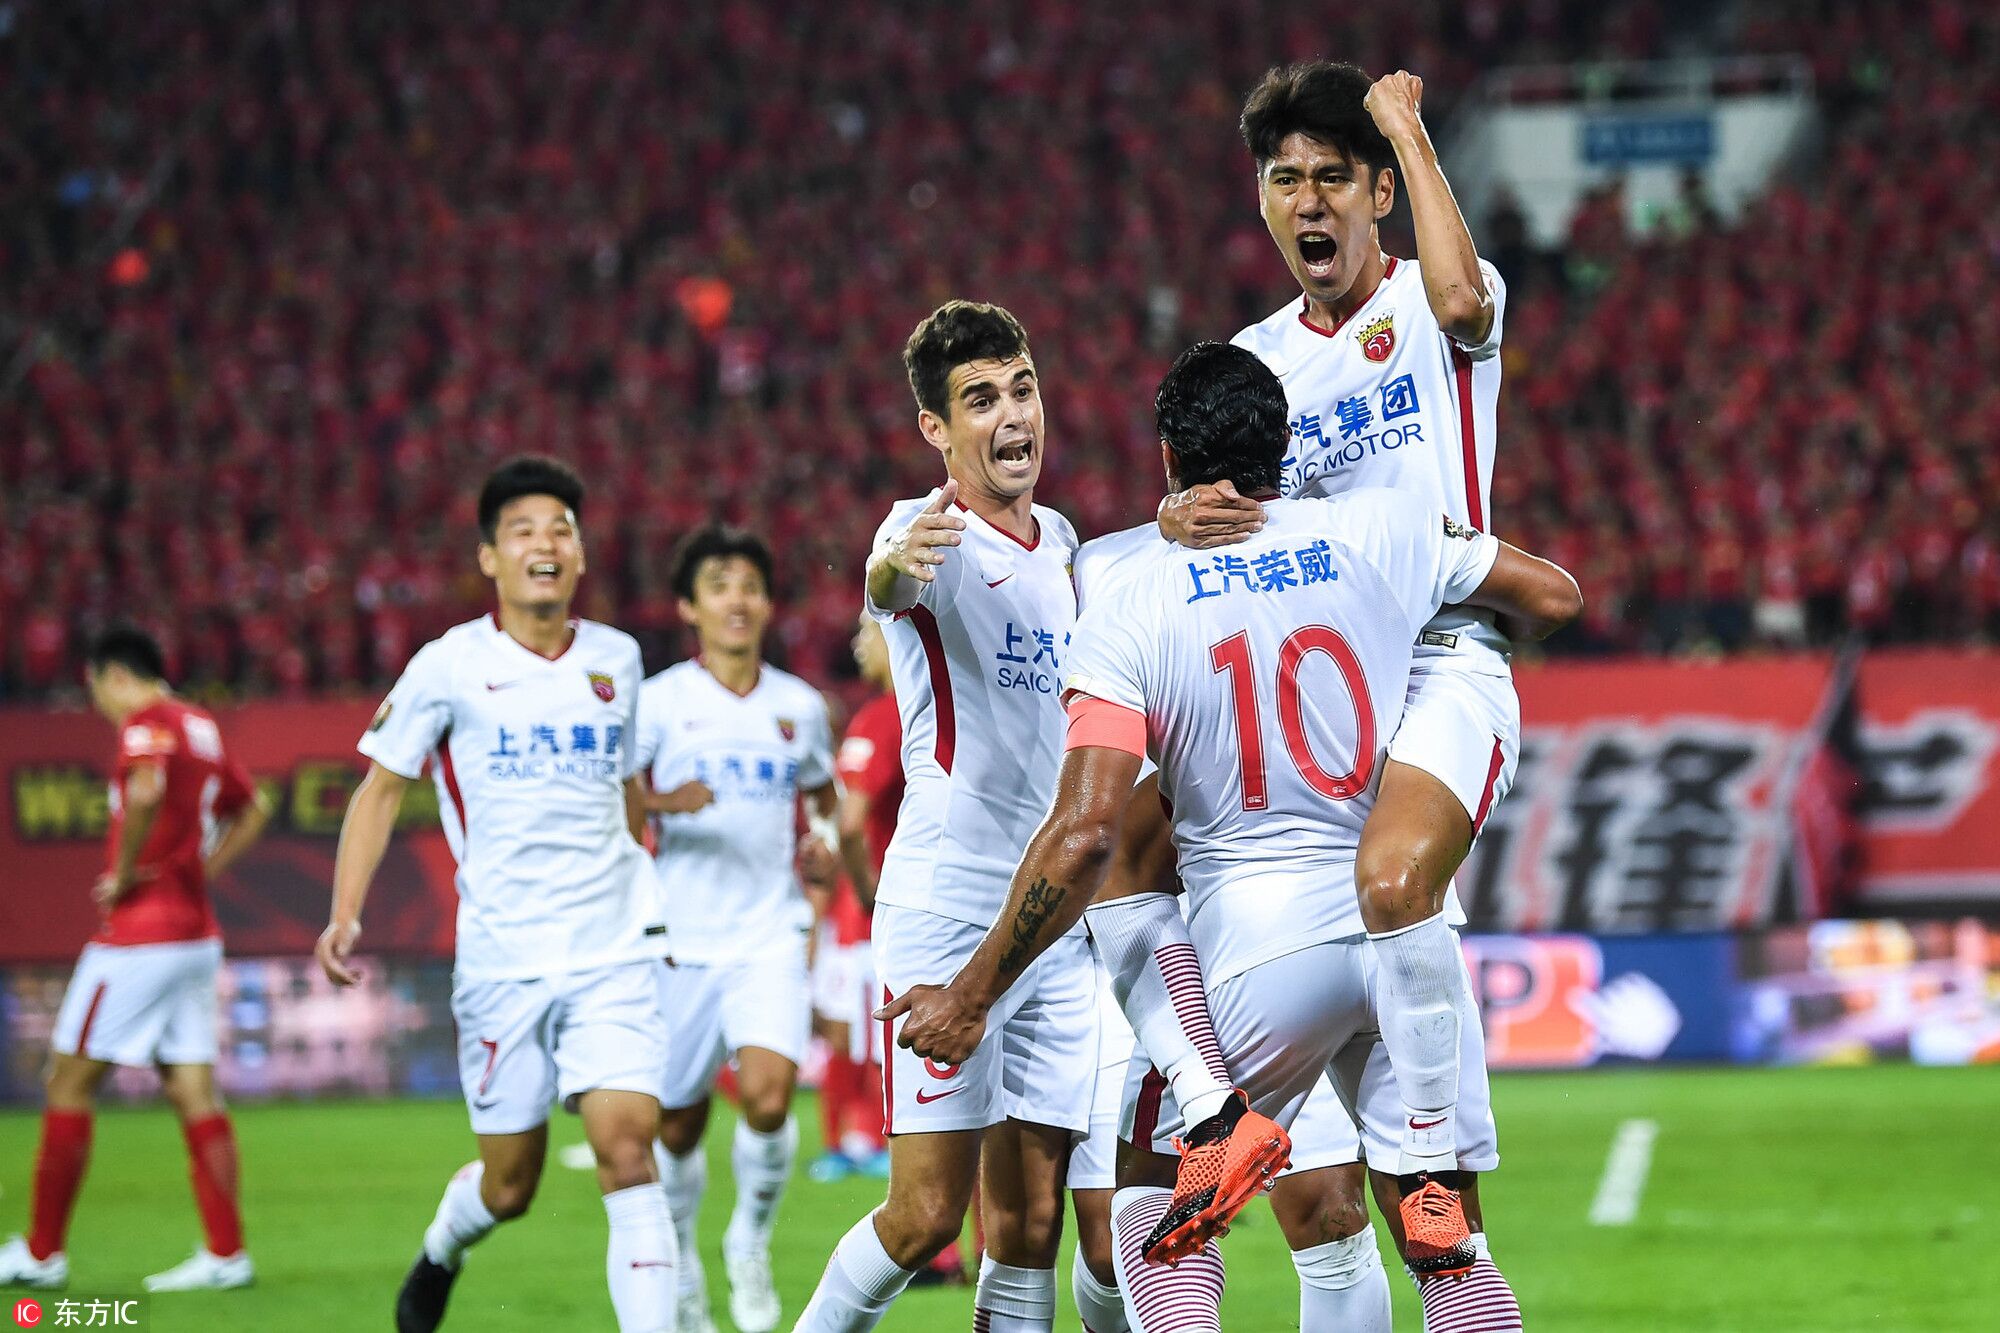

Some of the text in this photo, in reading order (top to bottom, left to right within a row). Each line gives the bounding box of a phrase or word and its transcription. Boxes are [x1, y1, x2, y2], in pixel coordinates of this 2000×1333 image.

[1280, 373, 1420, 468] 汽集团
[1323, 422, 1425, 472] MOTOR
[1186, 538, 1339, 605] 上汽荣威
[996, 622, 1072, 669] 上汽
[997, 667, 1052, 694] SAIC
[1209, 623, 1377, 813] 10
[479, 1038, 498, 1097] 7
